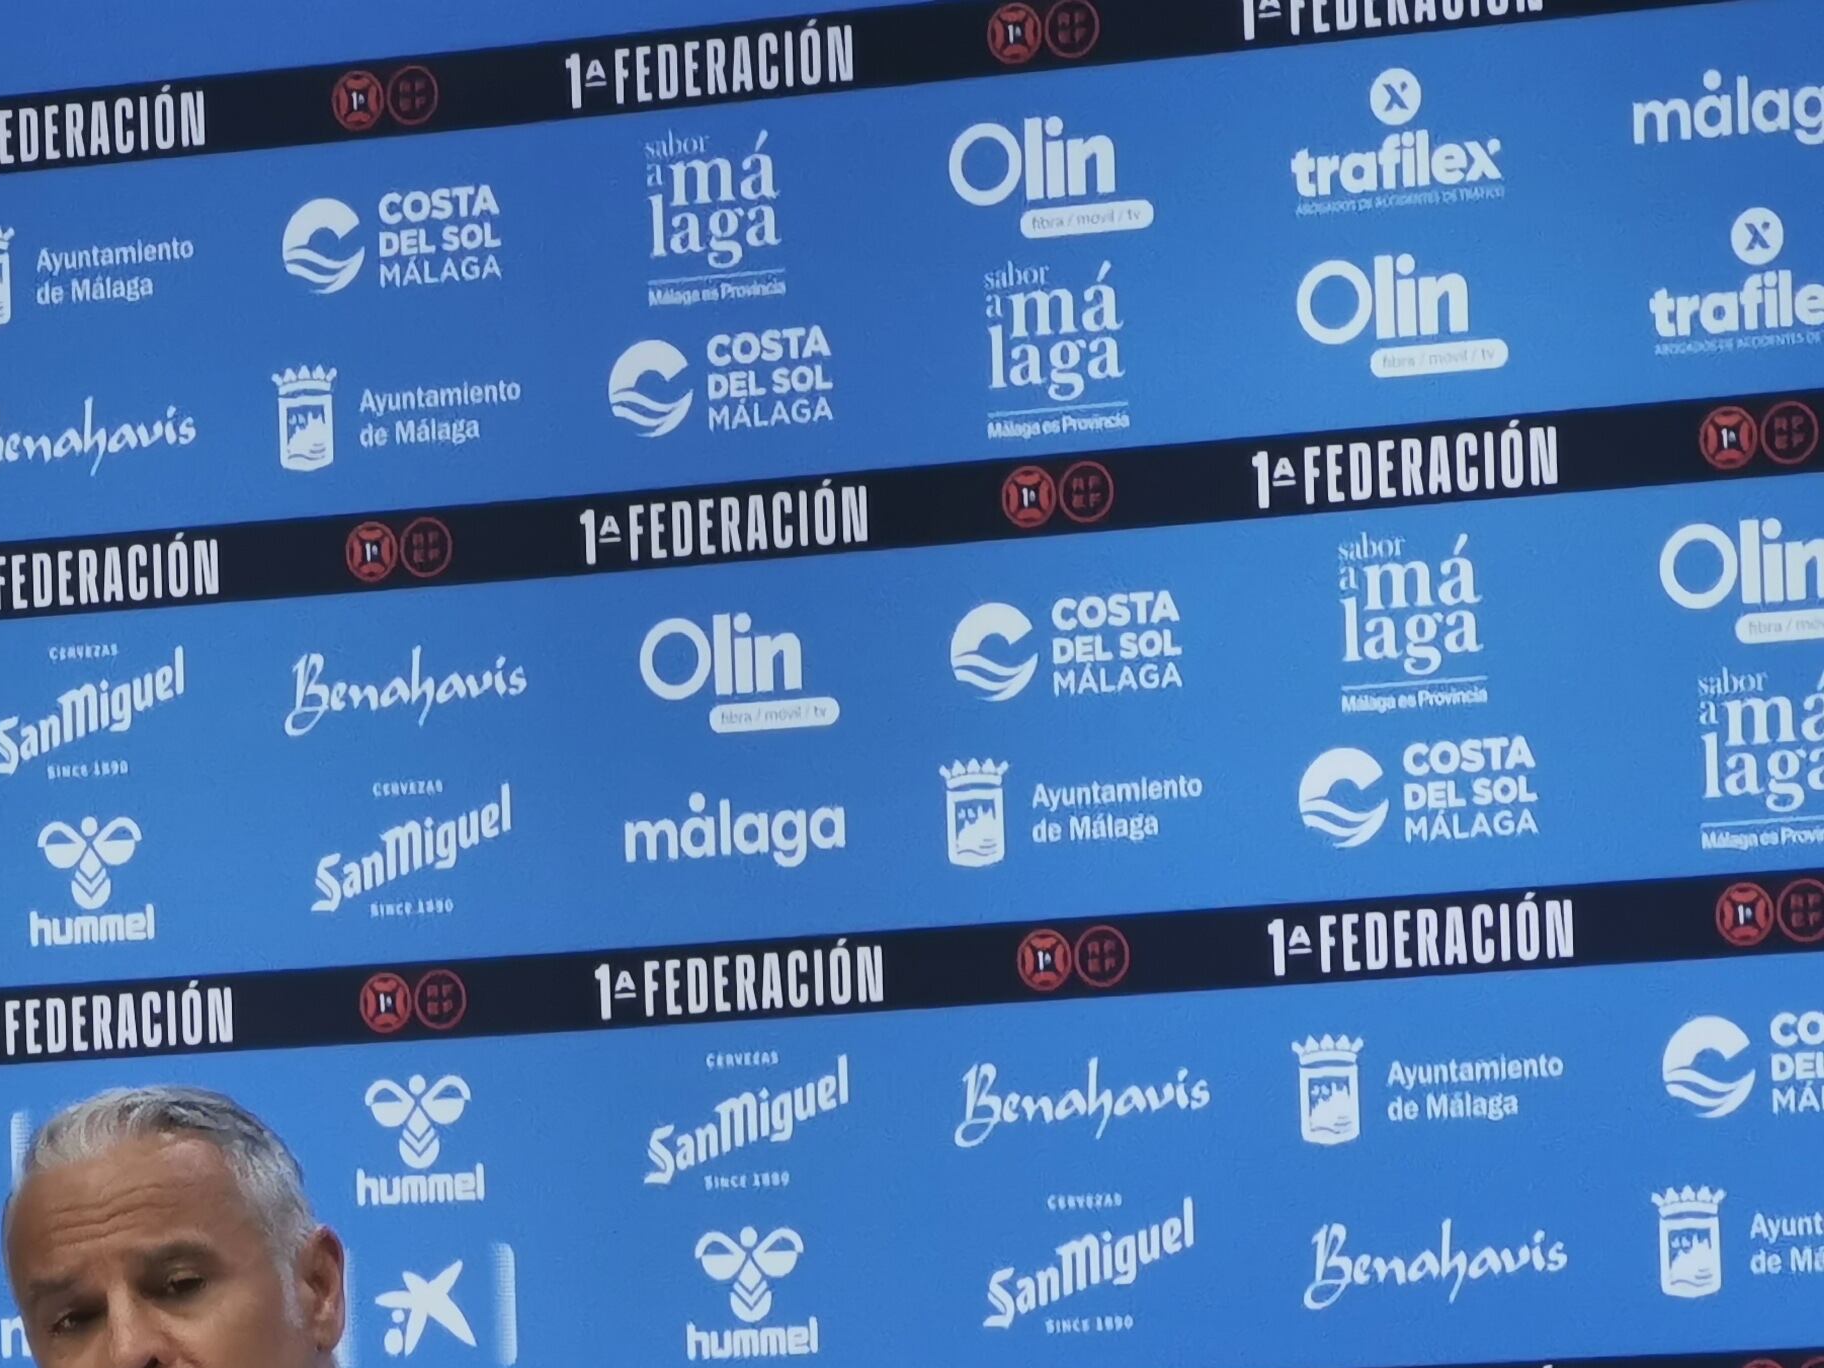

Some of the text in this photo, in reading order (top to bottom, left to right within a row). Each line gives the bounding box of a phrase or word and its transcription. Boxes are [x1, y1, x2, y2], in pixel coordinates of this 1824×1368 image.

[614, 18, 854, 104] FEDERACIÓN
[948, 115, 1116, 207] Olin
[1290, 129, 1502, 198] trafilex
[378, 184, 500, 225] COSTA
[36, 237, 194, 276] Ayuntamiento
[379, 222, 502, 258] DEL SOL
[36, 275, 154, 305] de Málaga
[380, 254, 501, 288] MÁLAGA
[1296, 253, 1469, 345] Olin
[707, 325, 832, 367] COSTA
[359, 379, 521, 417] Ayuntamiento
[707, 364, 834, 401] DEL SOL
[359, 418, 480, 448] de Málaga
[708, 396, 833, 431] MÁLAGA
[1303, 419, 1558, 505] FEDERACIÓN
[628, 478, 868, 561] FEDERACIÓN
[1338, 532, 1405, 561] sabor
[1051, 590, 1180, 631] COSTA
[639, 612, 803, 701] Olin
[1052, 628, 1183, 665] DEL SOL
[1340, 597, 1484, 675] laga
[1053, 661, 1183, 696] MÁLAGA
[1403, 735, 1536, 776] COSTA
[1032, 774, 1203, 813] Ayuntamiento
[1403, 774, 1539, 811] DEL SOL
[1032, 812, 1159, 843] de Málaga
[1405, 808, 1538, 842] MÁLAGA
[29, 903, 155, 947] hummel
[1319, 891, 1574, 973] FEDERACIÓN
[643, 938, 884, 1017] FEDERACIÓN
[4, 980, 234, 1056] FEDERACIÓN
[1387, 1053, 1564, 1091] Ayuntamiento
[1387, 1090, 1519, 1122] de Málaga
[356, 1162, 485, 1207] hummel
[686, 1316, 819, 1361] hummel
